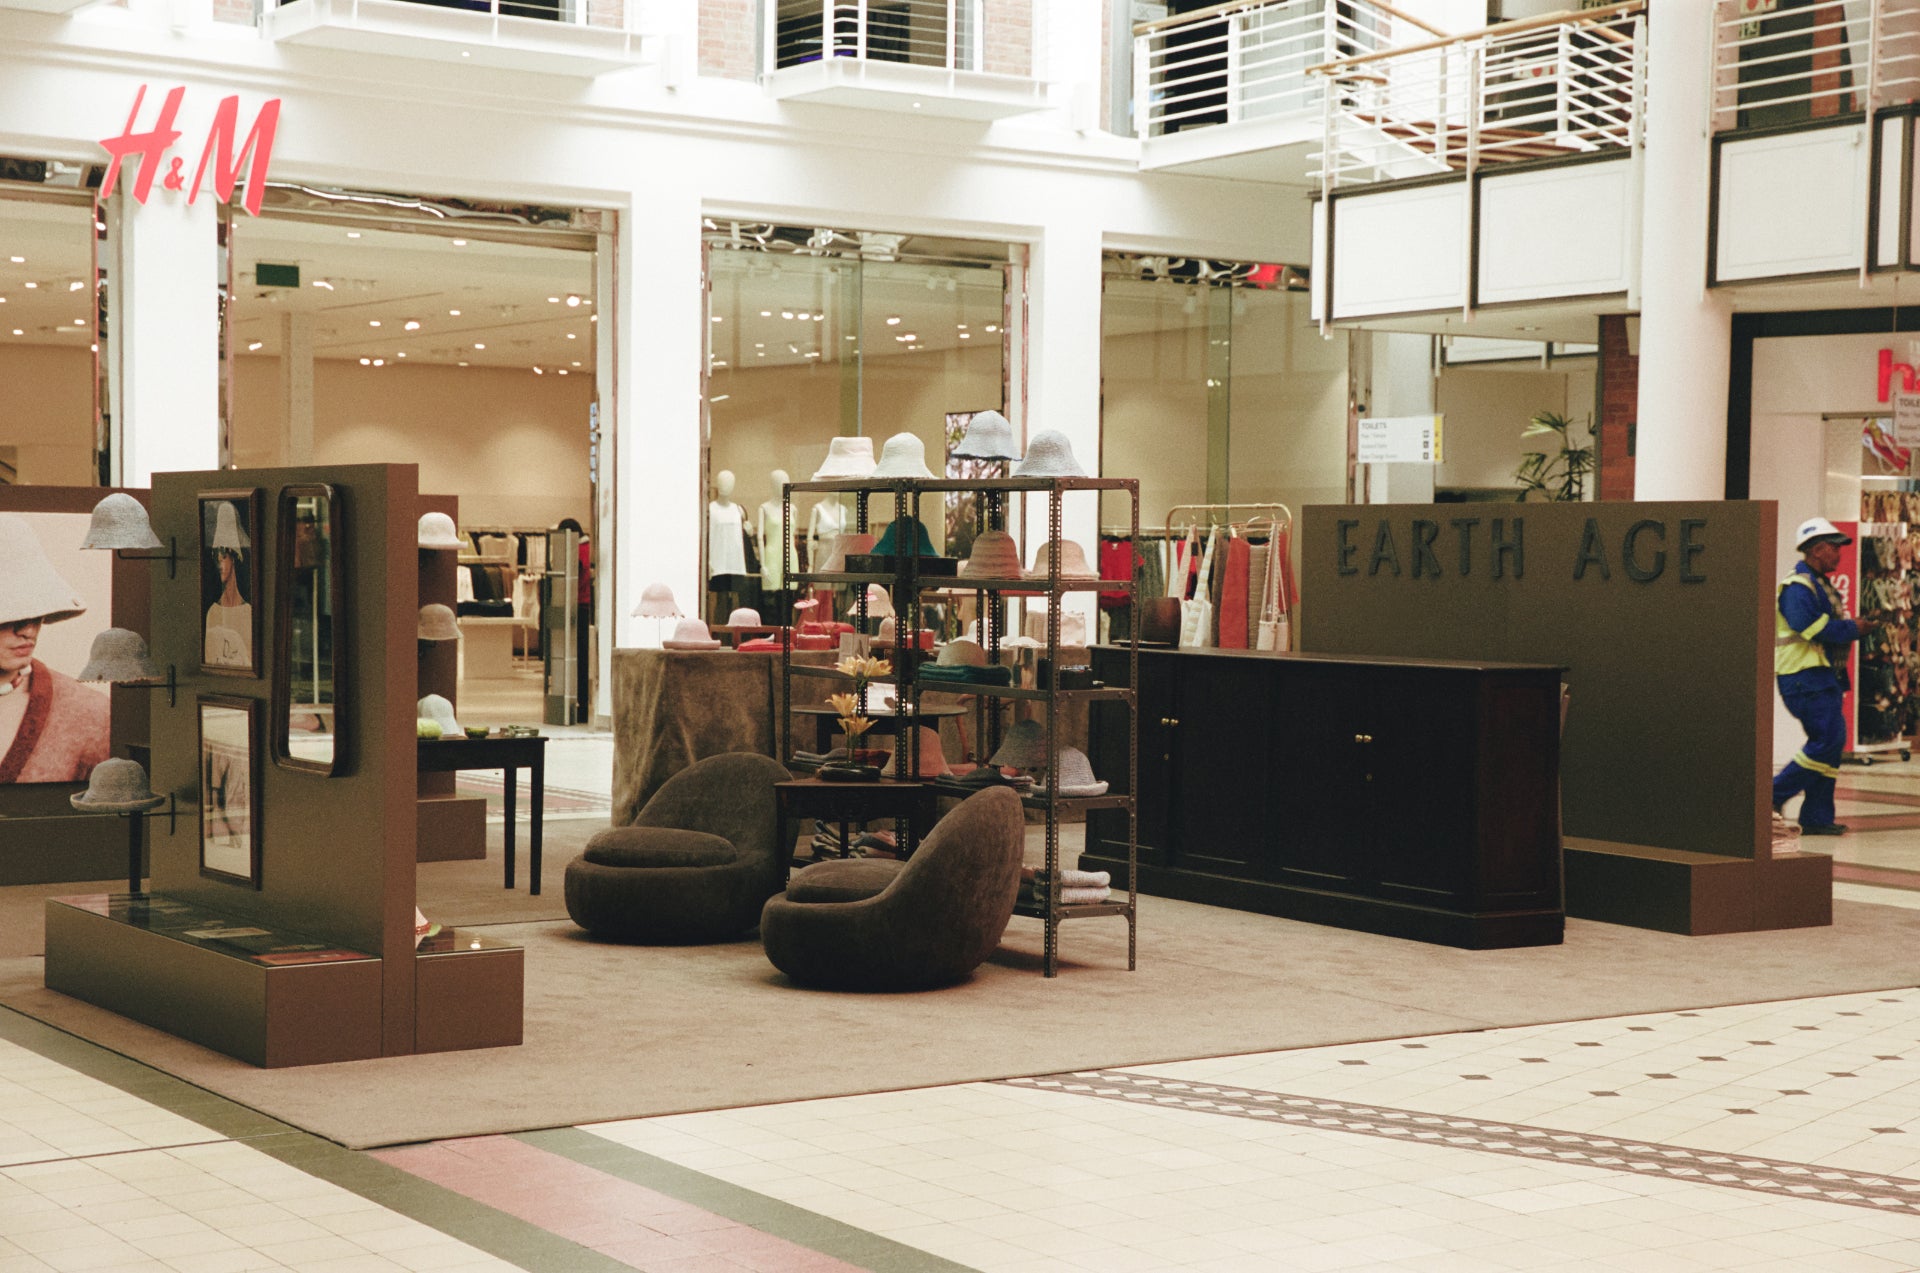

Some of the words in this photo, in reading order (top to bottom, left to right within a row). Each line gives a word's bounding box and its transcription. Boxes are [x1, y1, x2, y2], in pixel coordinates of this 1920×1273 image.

[99, 84, 281, 217] H&M
[1337, 518, 1524, 580] EARTH
[1573, 518, 1707, 584] AGE
